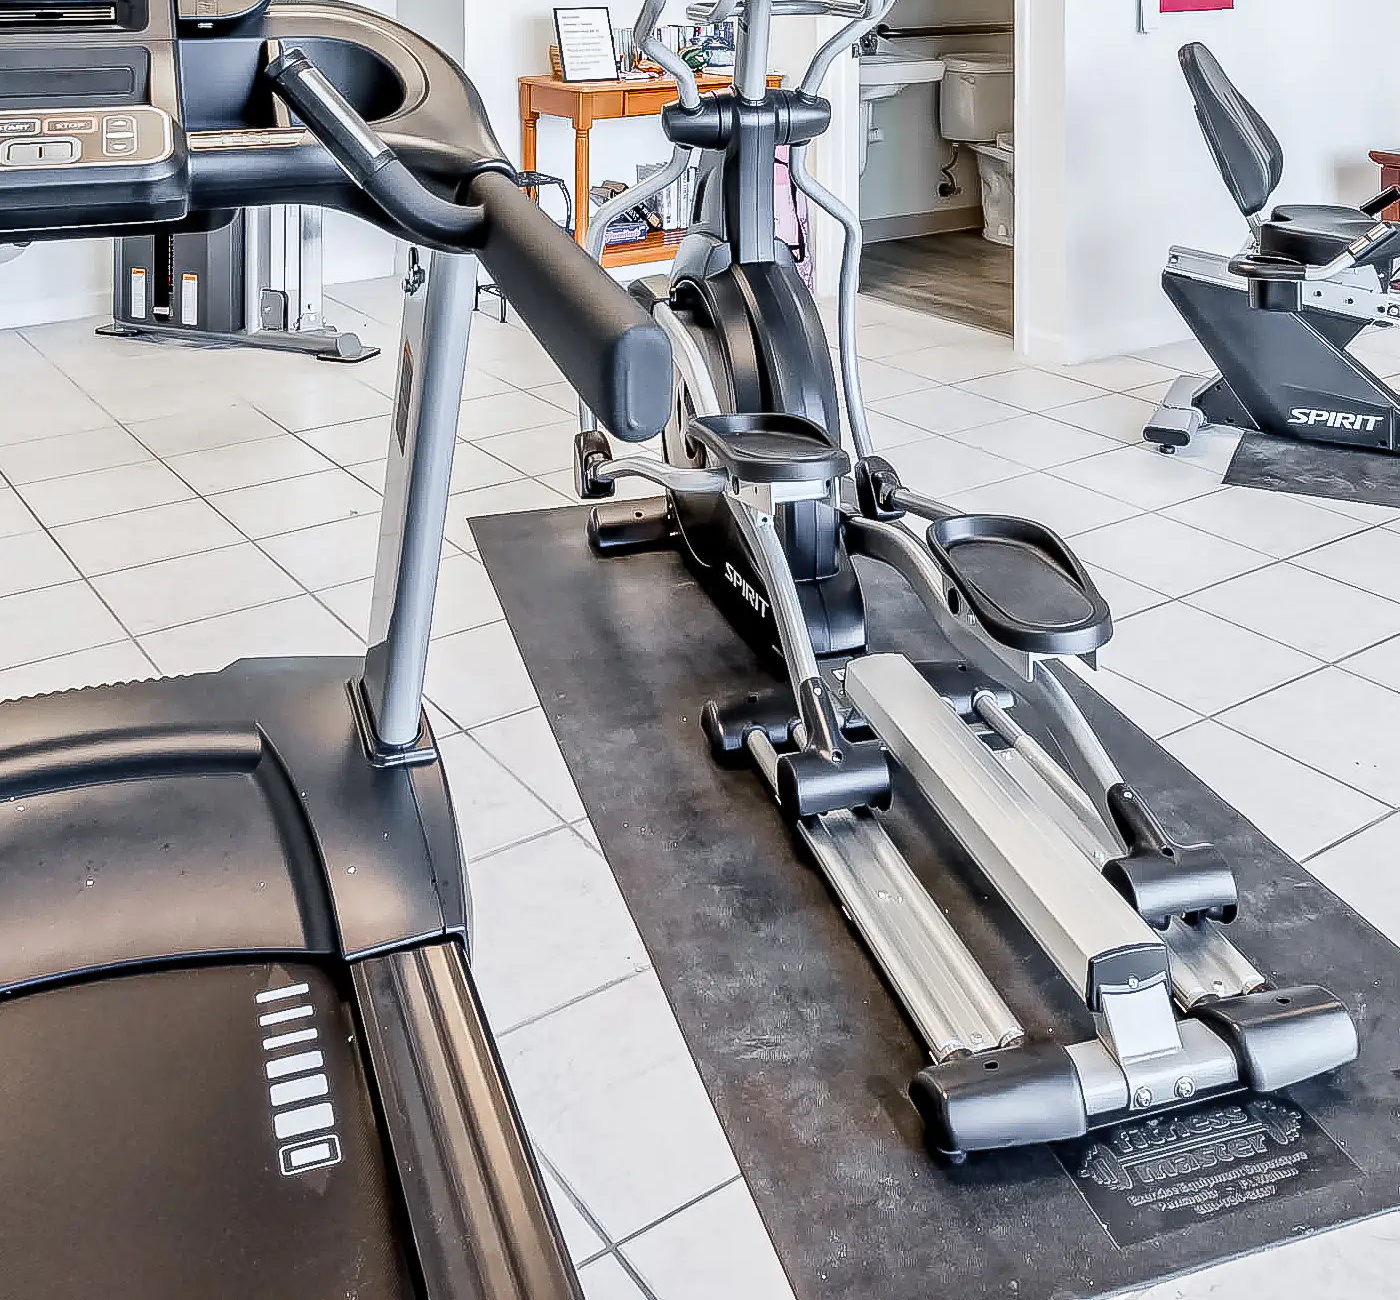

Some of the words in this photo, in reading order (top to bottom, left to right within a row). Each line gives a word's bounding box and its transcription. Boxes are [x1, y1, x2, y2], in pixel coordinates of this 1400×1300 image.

[0, 123, 30, 132] TART
[55, 120, 88, 130] STOP
[1287, 408, 1385, 431] SPIRIT
[724, 561, 770, 619] SPIRIT
